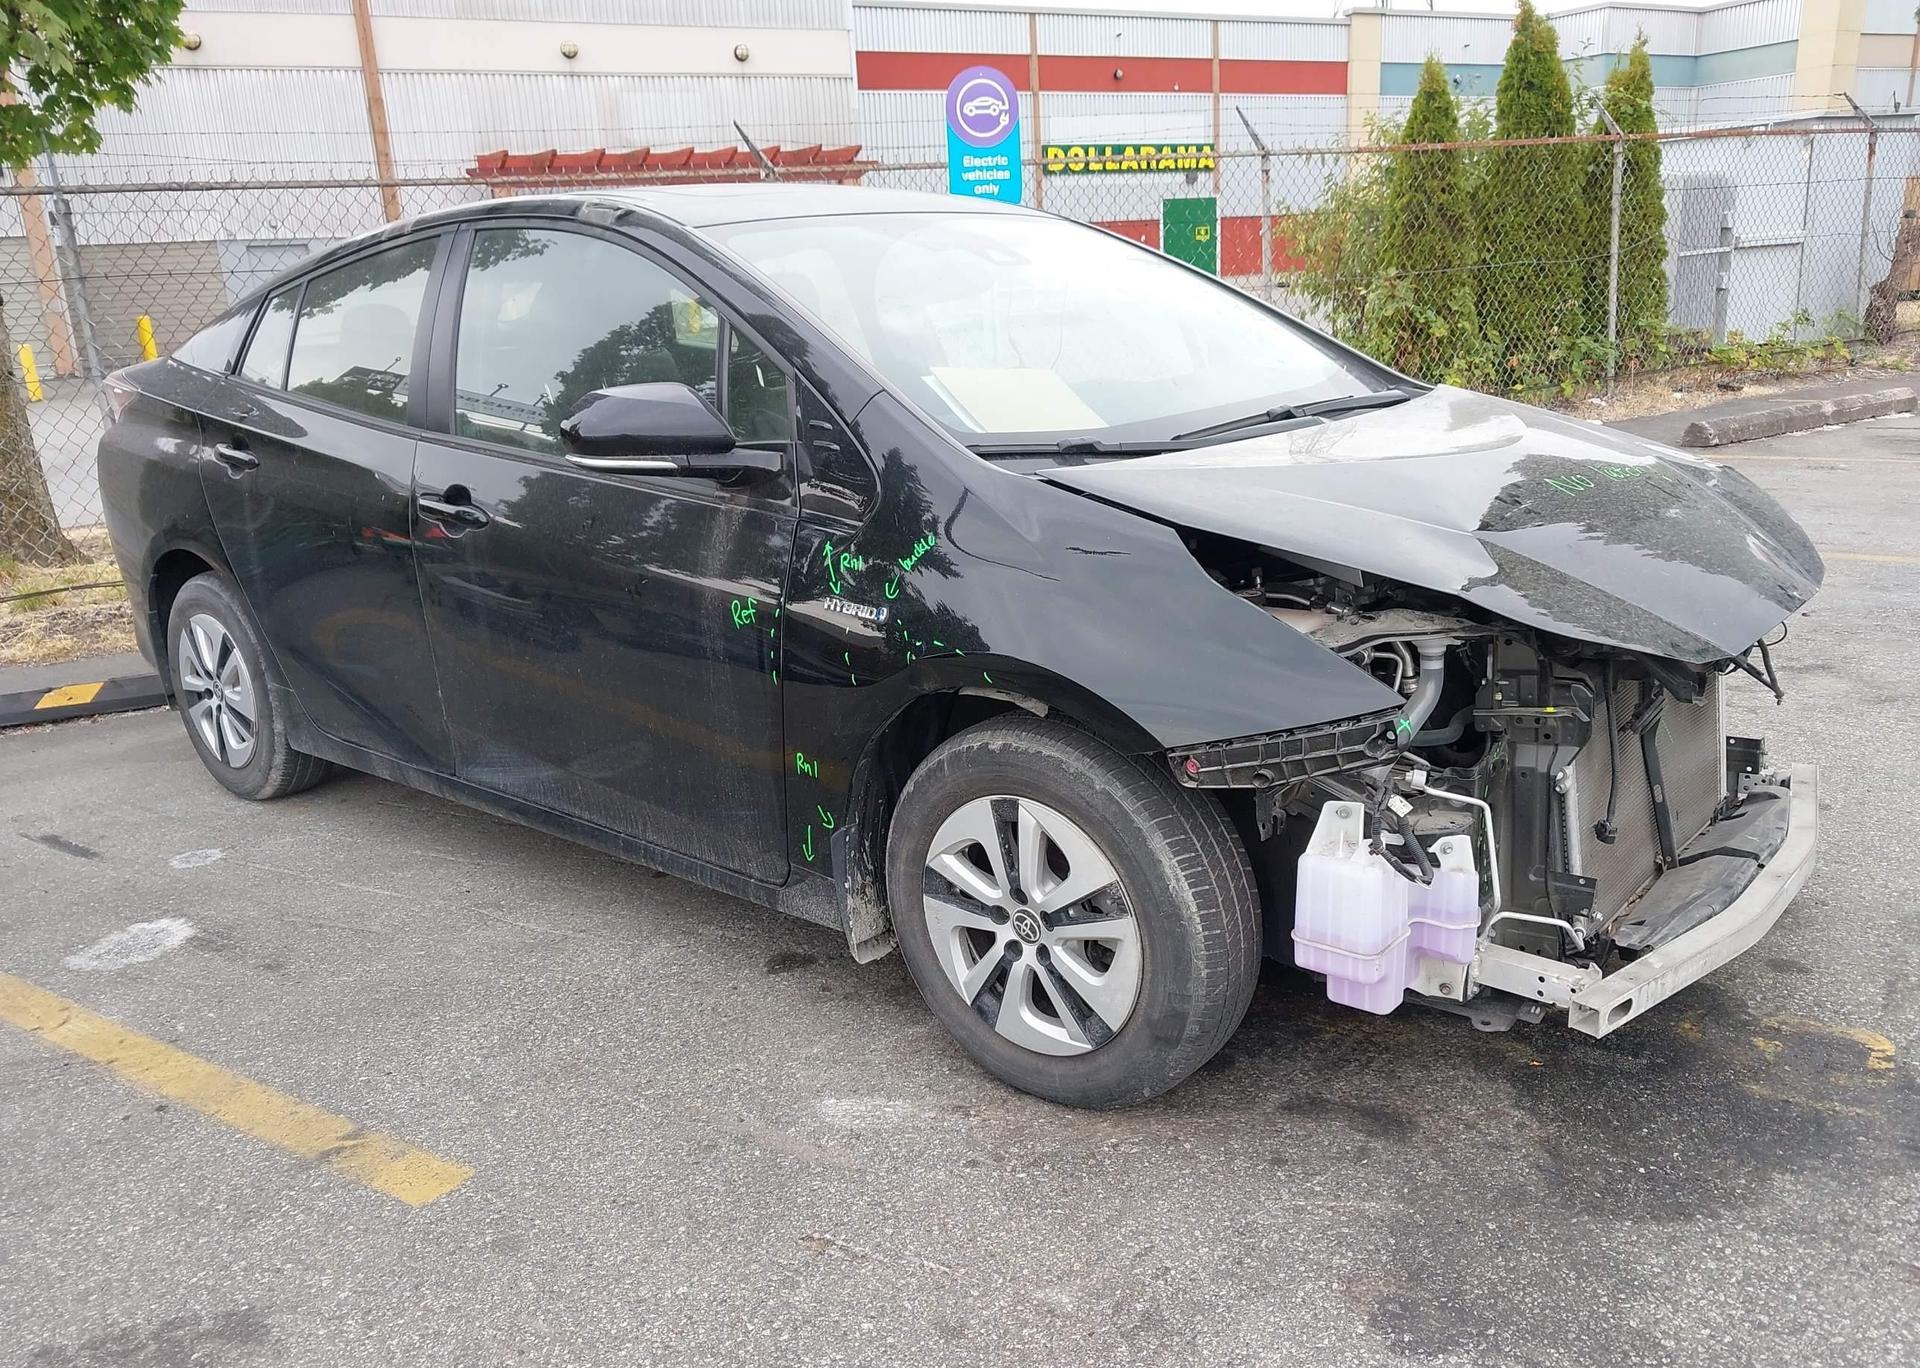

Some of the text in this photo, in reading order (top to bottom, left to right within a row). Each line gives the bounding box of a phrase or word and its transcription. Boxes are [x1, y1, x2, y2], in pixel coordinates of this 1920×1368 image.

[963, 155, 1008, 167] Electric
[1047, 145, 1216, 171] DOLLARAMA
[961, 169, 1010, 181] vehicles
[974, 183, 1000, 196] only
[731, 597, 757, 629] Ref
[824, 597, 876, 619] HYBRID
